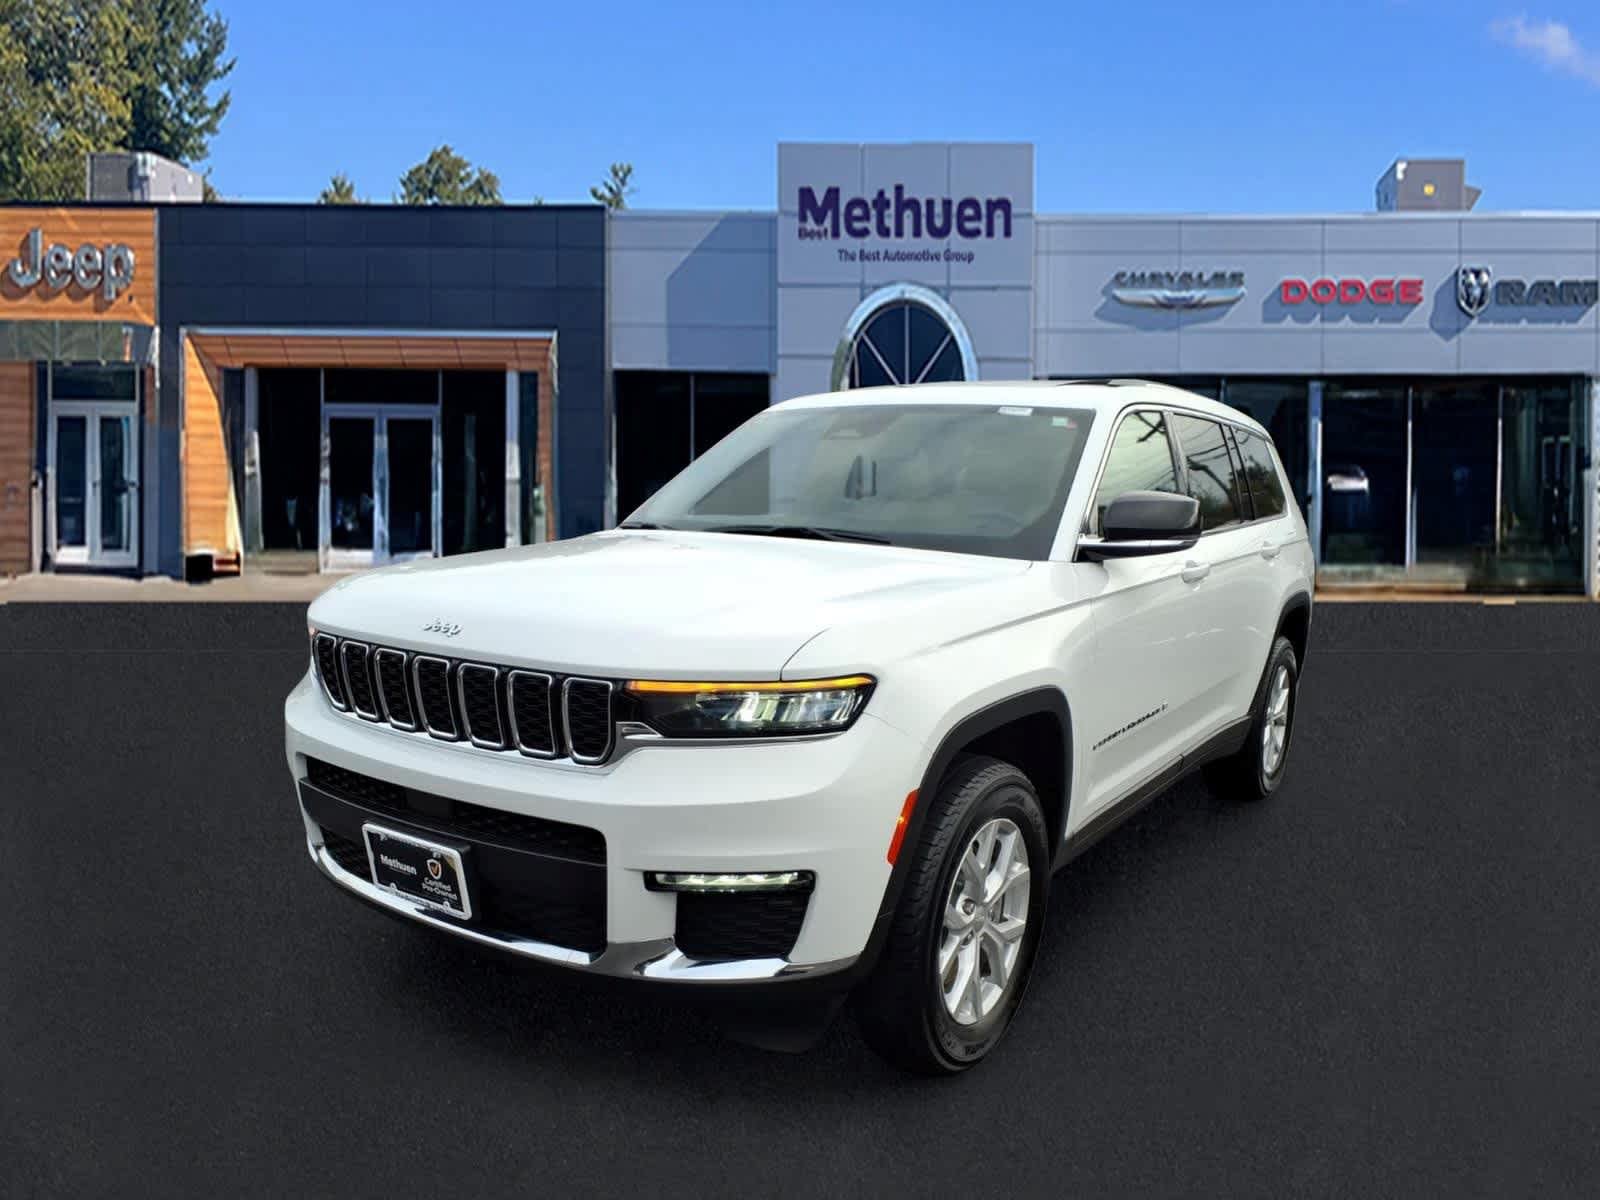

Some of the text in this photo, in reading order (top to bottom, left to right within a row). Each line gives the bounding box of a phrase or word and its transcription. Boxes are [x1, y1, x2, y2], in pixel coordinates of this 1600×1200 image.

[798, 184, 1012, 239] Methuen
[798, 227, 828, 240] Best
[8, 228, 135, 299] Jeep
[838, 248, 975, 264] The Best Automotive Group
[1281, 278, 1424, 304] DODGE
[1496, 279, 1599, 304] RAM
